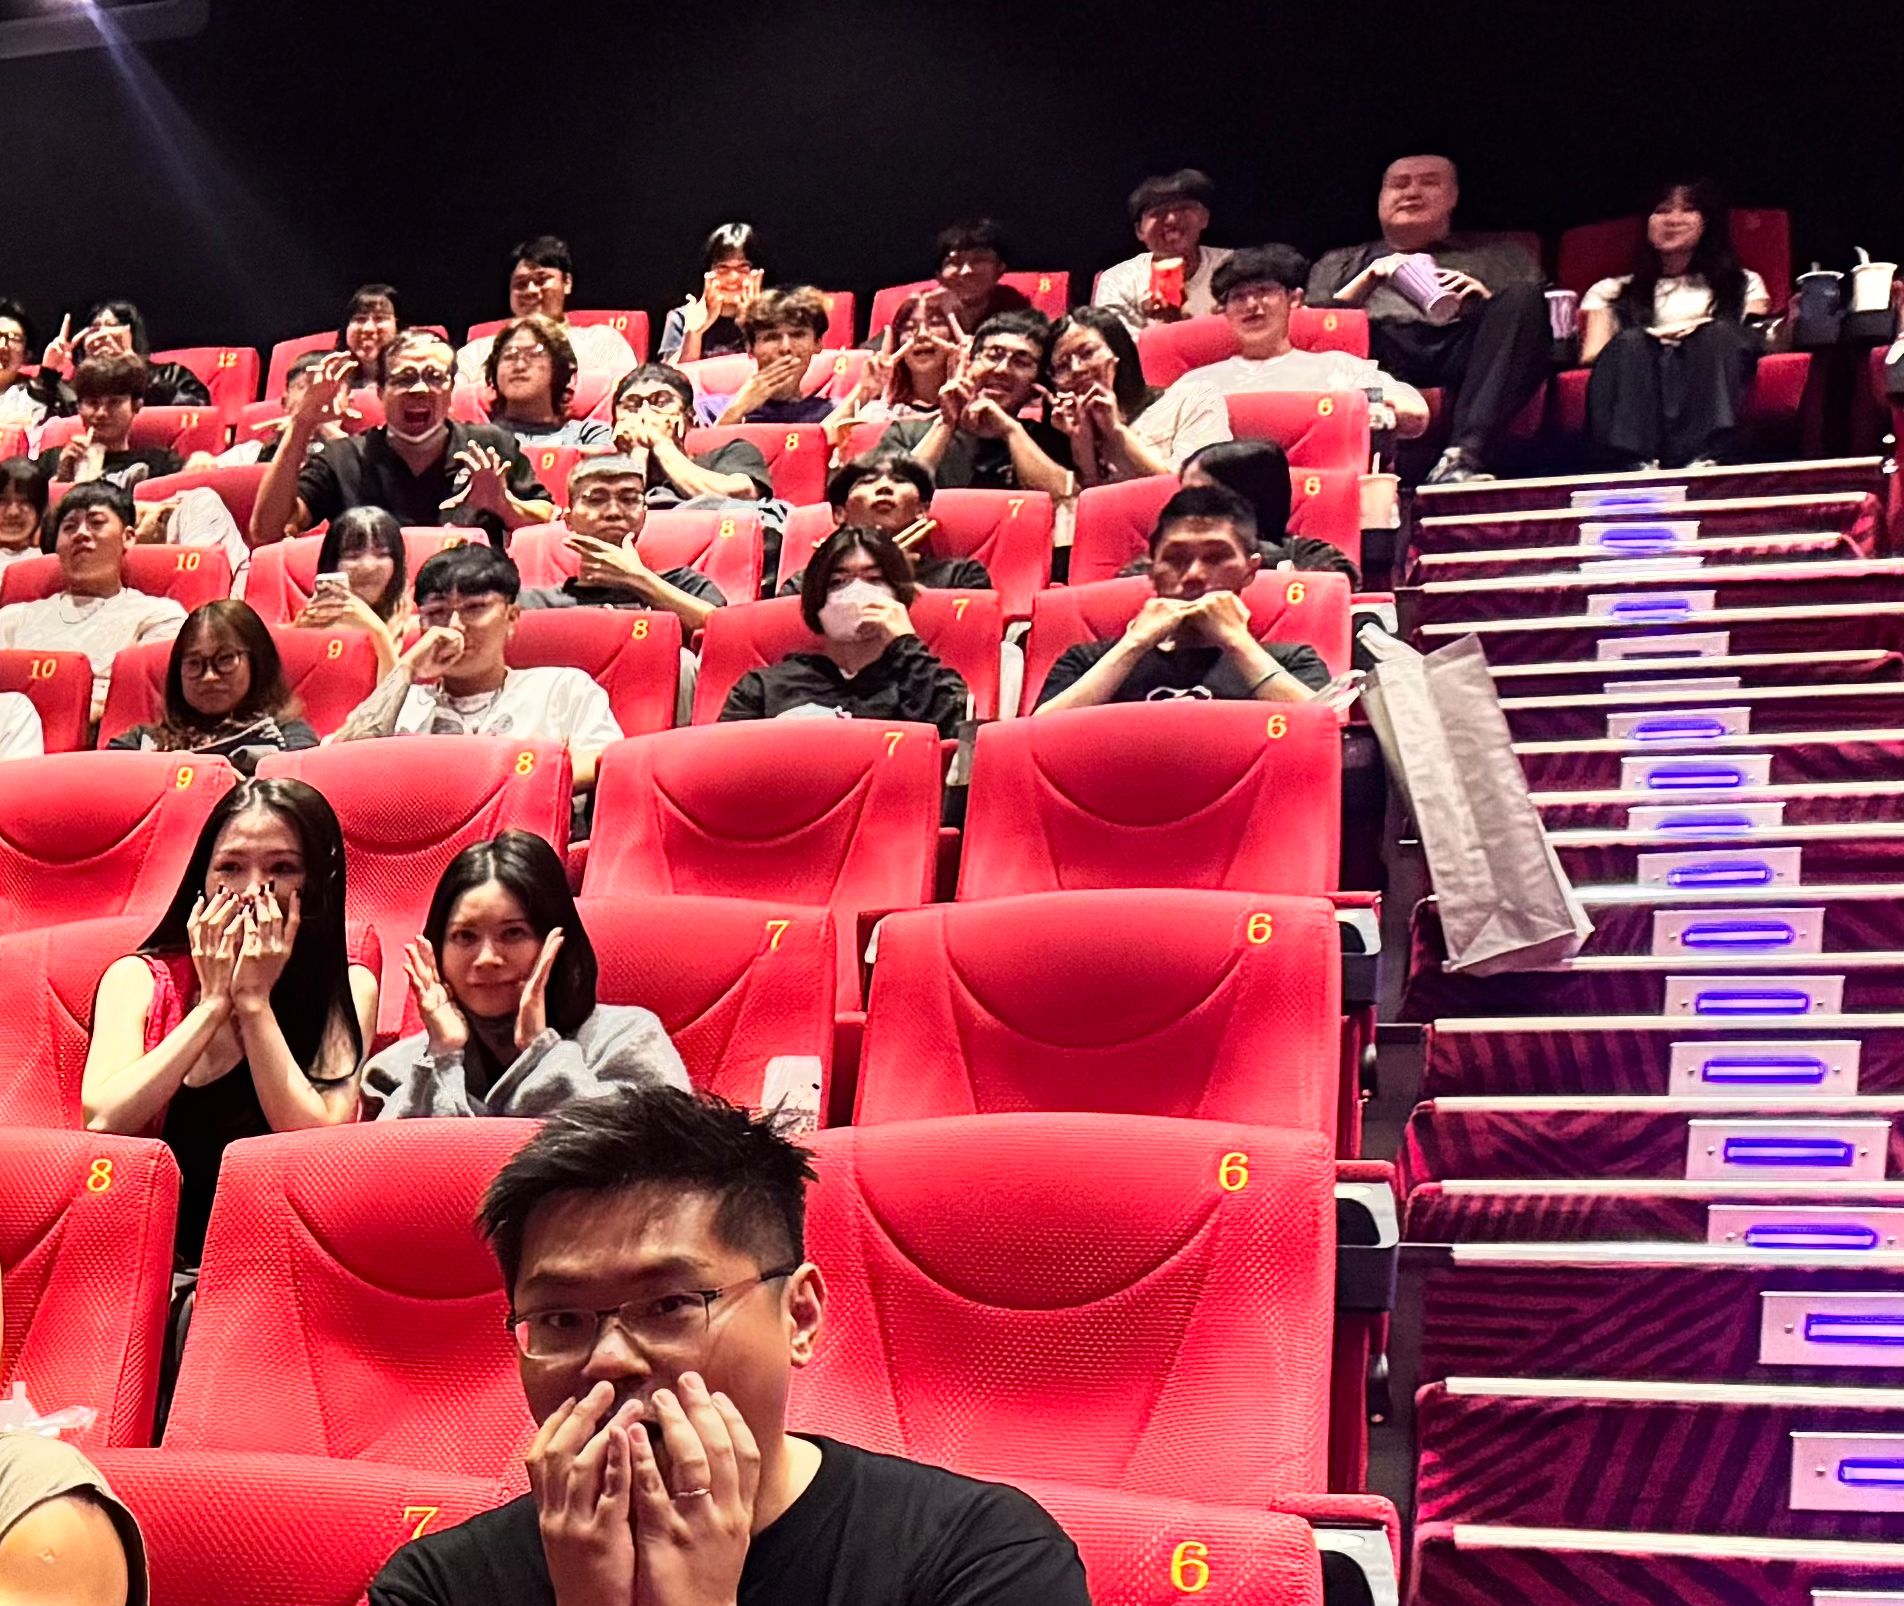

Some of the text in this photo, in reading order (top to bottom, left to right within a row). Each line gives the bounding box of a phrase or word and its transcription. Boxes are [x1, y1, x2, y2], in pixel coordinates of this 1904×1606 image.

[1325, 315, 1337, 330] 6
[219, 354, 236, 367] 12
[1318, 399, 1332, 414] 6
[1305, 477, 1320, 496] 6
[1007, 499, 1023, 518] 7
[721, 520, 736, 538] 8
[176, 552, 201, 571] 10
[1288, 583, 1303, 603] 6
[954, 599, 969, 619] 7
[632, 619, 648, 640] 8
[329, 640, 343, 658] 9
[32, 655, 57, 678] 10
[1267, 714, 1286, 738] 6
[884, 732, 904, 757] 7
[516, 752, 534, 774] 8
[177, 768, 194, 788] 9
[768, 920, 789, 949] 7
[1248, 915, 1271, 943] 6
[88, 1160, 112, 1192] 8
[1219, 1154, 1248, 1191] 6
[404, 1506, 438, 1539] 7
[1172, 1543, 1209, 1590] 6
